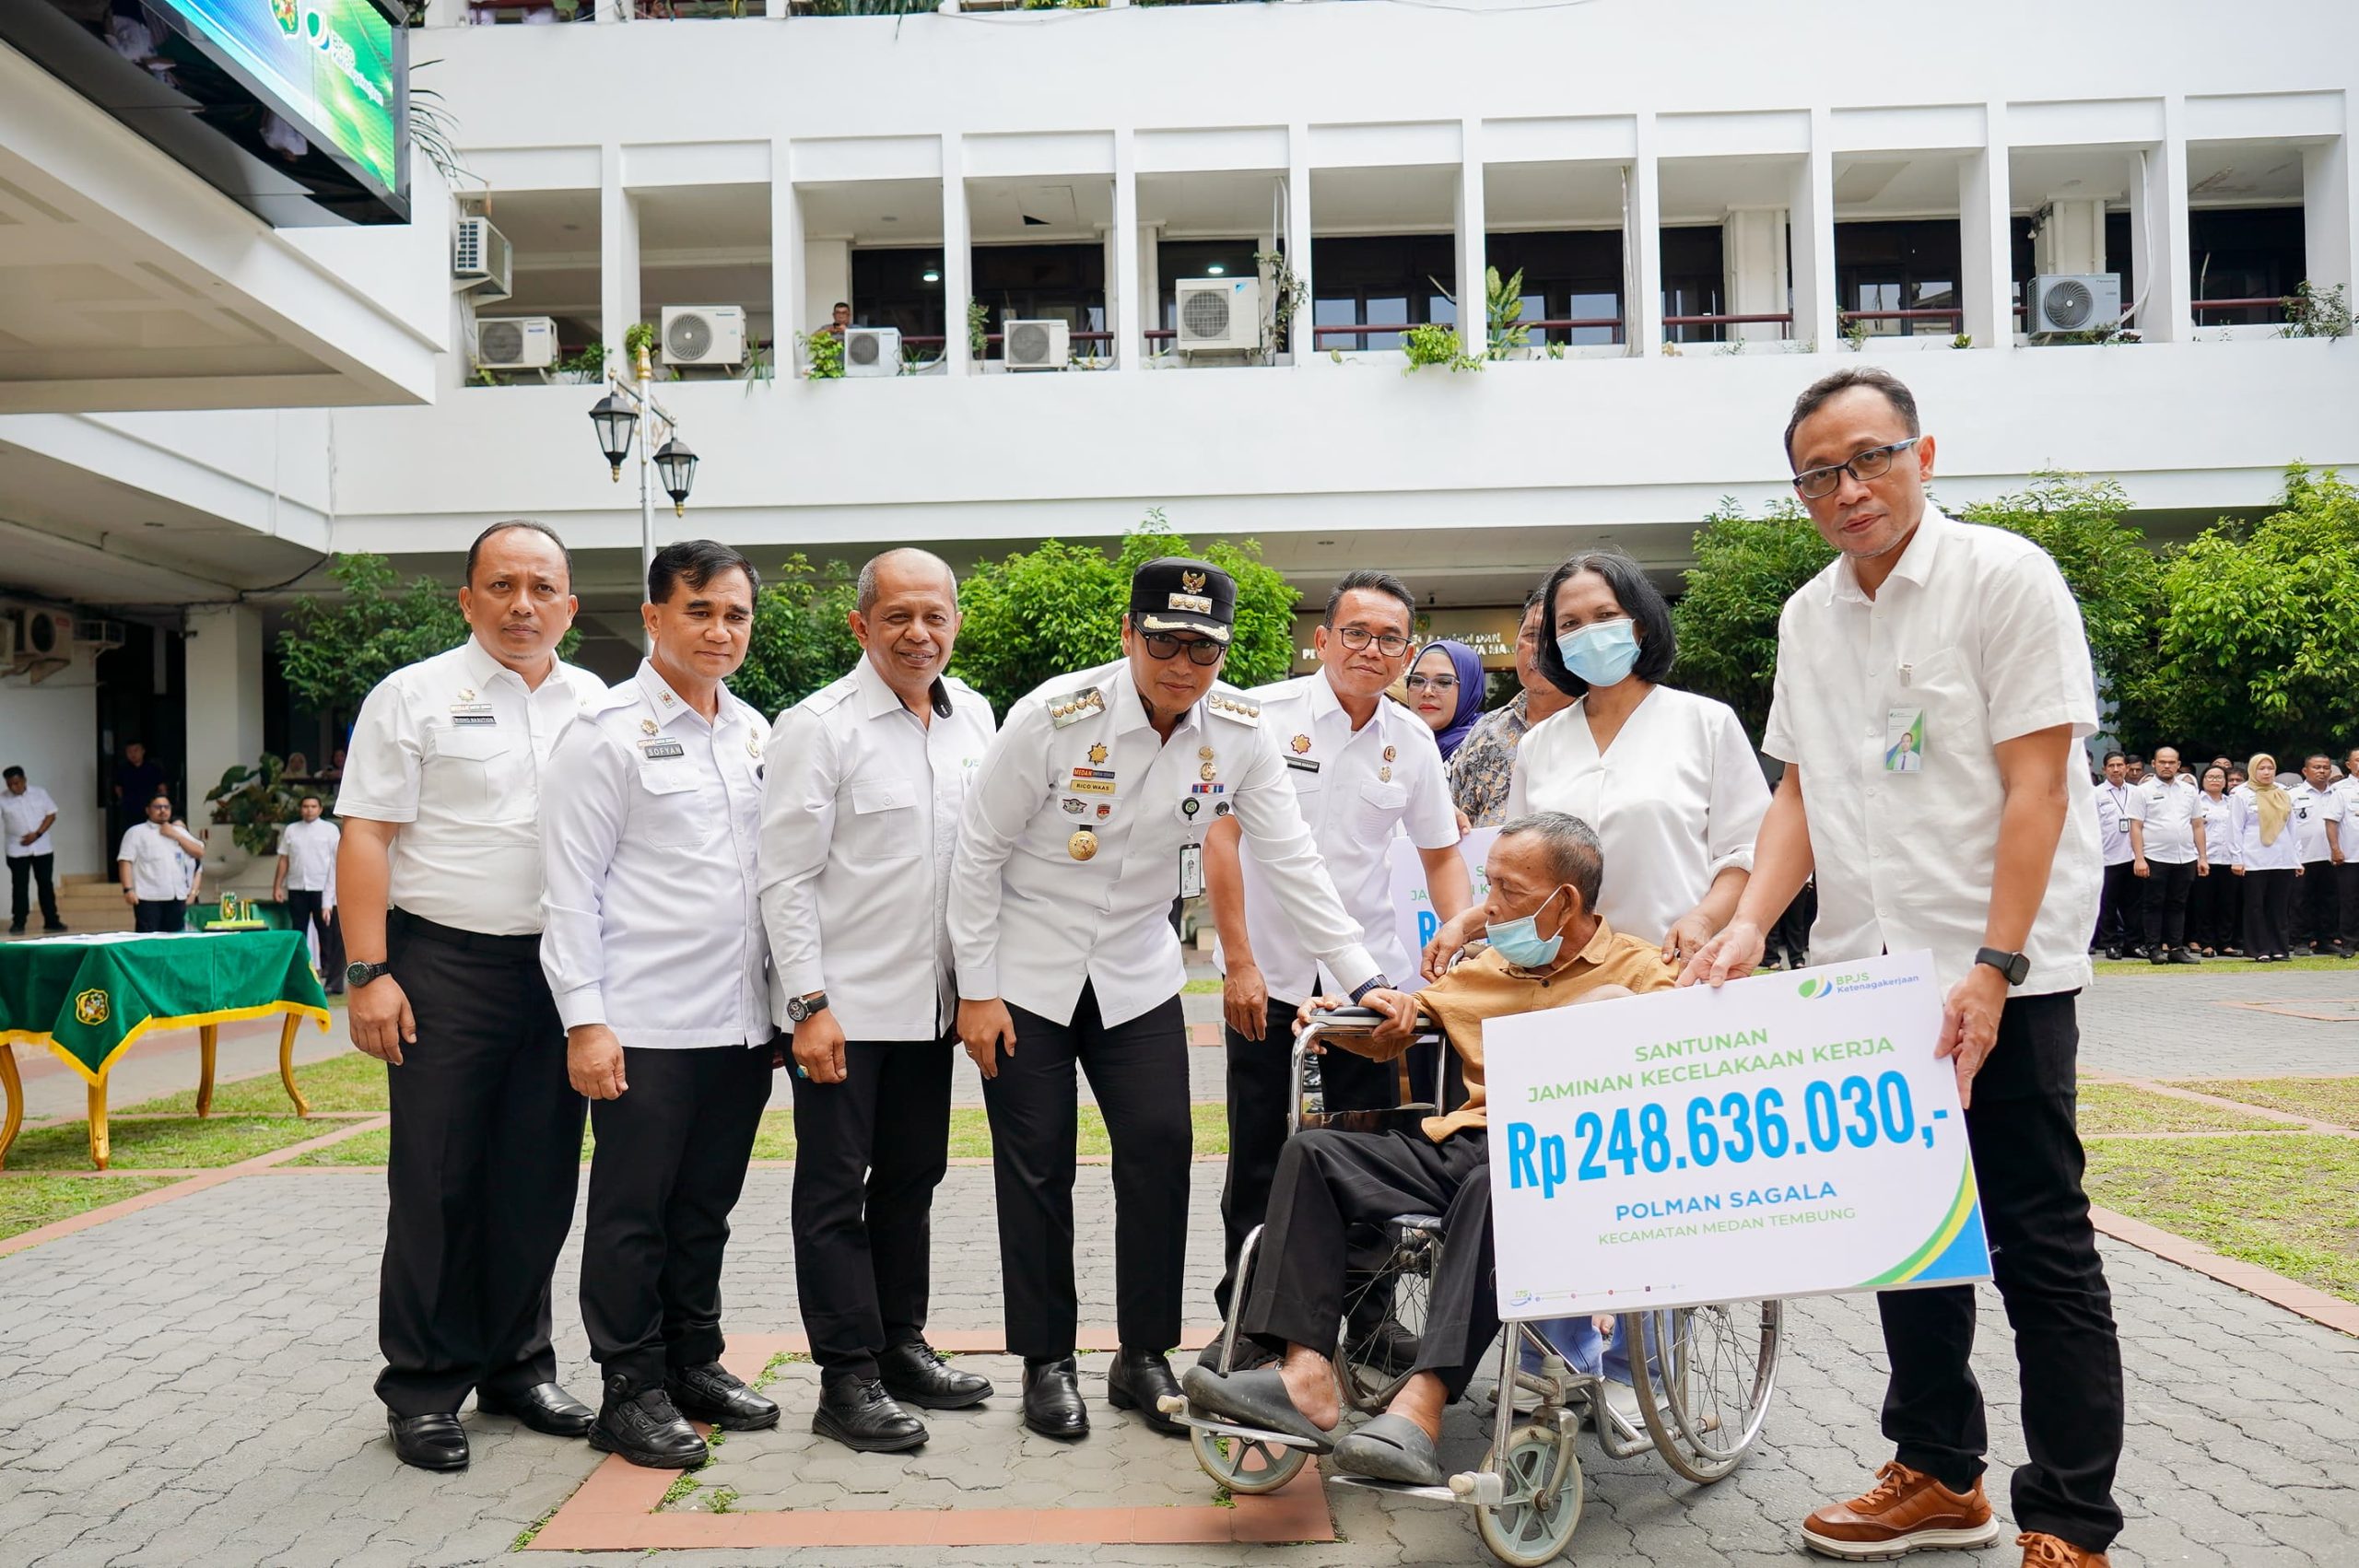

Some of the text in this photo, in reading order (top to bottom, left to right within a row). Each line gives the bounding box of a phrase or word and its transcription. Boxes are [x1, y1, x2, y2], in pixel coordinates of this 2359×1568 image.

[648, 746, 682, 756] SOFYAN
[1074, 768, 1092, 777] MEDAN
[1836, 972, 1870, 986] BPJS
[1837, 975, 1919, 993] Ketenagakerjaan
[1635, 1028, 1768, 1062] SANTUNAN
[1528, 1036, 1895, 1103] JAMINAN KECELAKAAN KERJA
[1615, 1181, 1837, 1221] POLMAN SAGALA
[1599, 1207, 1856, 1246] KECAMATAN MEDAN TEMBUNG
